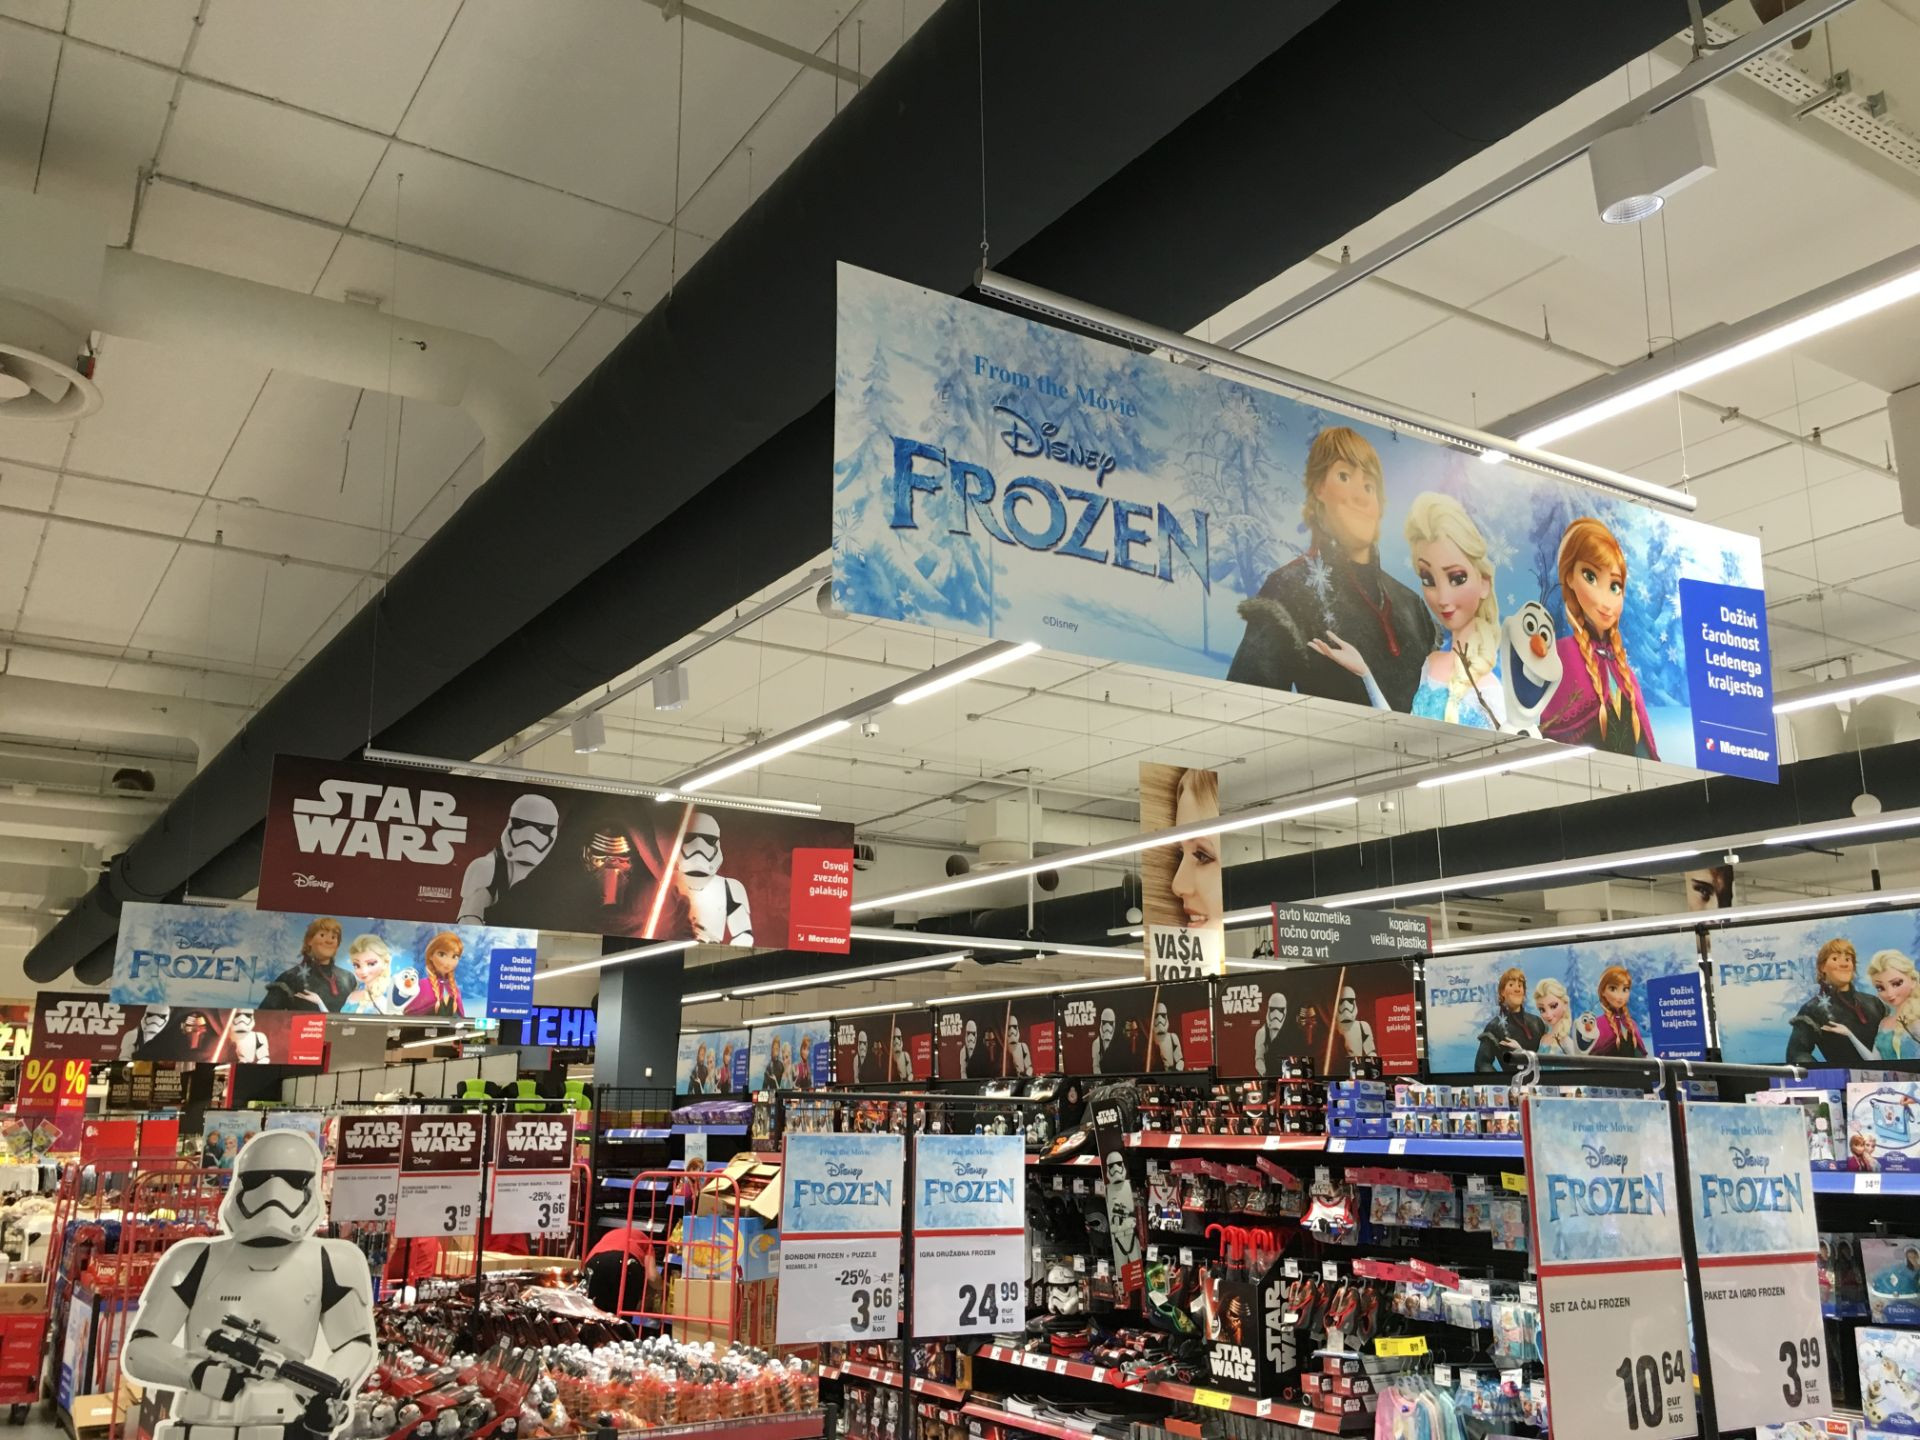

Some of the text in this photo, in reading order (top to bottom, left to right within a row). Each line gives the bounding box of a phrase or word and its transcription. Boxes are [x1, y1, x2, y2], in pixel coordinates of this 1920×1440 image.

[973, 354, 1138, 418] From the Movie
[993, 405, 1117, 488] Disney
[889, 434, 1211, 596] FROZEN
[1720, 606, 1759, 630] Doživi
[1701, 623, 1760, 652] čarobnost
[1705, 648, 1762, 678] Ledenega
[1707, 671, 1764, 699] kraljestva
[1719, 740, 1770, 762] Mercator
[293, 779, 468, 830] STAR
[292, 813, 467, 865] WARS
[822, 860, 849, 873] Osvoji
[291, 872, 334, 893] Disney
[813, 874, 849, 884] zvezdno
[809, 886, 848, 898] galaksijo
[1280, 909, 1351, 925] avto kozmetika
[1389, 917, 1426, 933] kopalnica
[808, 934, 846, 945] Mercator
[1280, 925, 1340, 944] ročno orodje
[1370, 934, 1428, 949] velika plastika
[1154, 929, 1203, 961] VAŠA
[1281, 945, 1329, 958] vse za vrt
[128, 949, 258, 984] FROZEN
[1719, 958, 1805, 986] FROZEN
[1222, 984, 1262, 1000] STAR
[1670, 986, 1694, 995] Doživi
[45, 1000, 126, 1019] STAR
[1064, 1000, 1096, 1014] STAR
[1222, 998, 1262, 1014] WARS
[1659, 998, 1695, 1007] čarobnost
[940, 1013, 963, 1025] STAR
[1064, 1012, 1096, 1027] WARS
[1661, 1009, 1696, 1017] Ledenega
[45, 1016, 125, 1036] WARS
[837, 1024, 856, 1036] STAR
[940, 1024, 962, 1037] WARS
[1662, 1019, 1697, 1029] kraljestva
[838, 1034, 855, 1045] WARS
[345, 1122, 402, 1135] STAR
[411, 1122, 476, 1137] STAR
[506, 1122, 568, 1136] STAR
[1573, 1121, 1634, 1132] From the Movie
[1741, 1126, 1752, 1135] the
[345, 1134, 402, 1149] WARS
[411, 1136, 476, 1152] WARS
[506, 1136, 567, 1151] WARS
[1581, 1144, 1628, 1174] Disney
[1729, 1146, 1770, 1174] Disney
[824, 1161, 863, 1180] Disney
[952, 1161, 988, 1179] Disney
[529, 1192, 552, 1201] -25%
[792, 1178, 893, 1209] FROZEN
[923, 1178, 1015, 1206] FROZEN
[1546, 1172, 1666, 1223] FROZEN
[1699, 1172, 1804, 1219] FROZEN
[374, 1194, 387, 1216] 3
[444, 1205, 471, 1231] 3 19
[538, 1202, 565, 1228] 3 66
[835, 1269, 871, 1285] -25%
[1704, 1287, 1785, 1300] PAKET ZA IGRO FROZEN
[850, 1287, 892, 1333] 3 66
[959, 1281, 1018, 1326] 24 99
[1550, 1297, 1630, 1313] SET ZA ČAJ FROZEN
[1265, 1280, 1281, 1374] STAR
[1210, 1343, 1255, 1366] STAR
[1210, 1358, 1255, 1383] WARS
[1780, 1337, 1821, 1408] 3 99
[1616, 1349, 1685, 1431] 10 64
[1805, 1379, 1817, 1389] eur
[1667, 1396, 1681, 1406] eur
[1807, 1394, 1820, 1405] kos
[1669, 1412, 1684, 1424] kos
